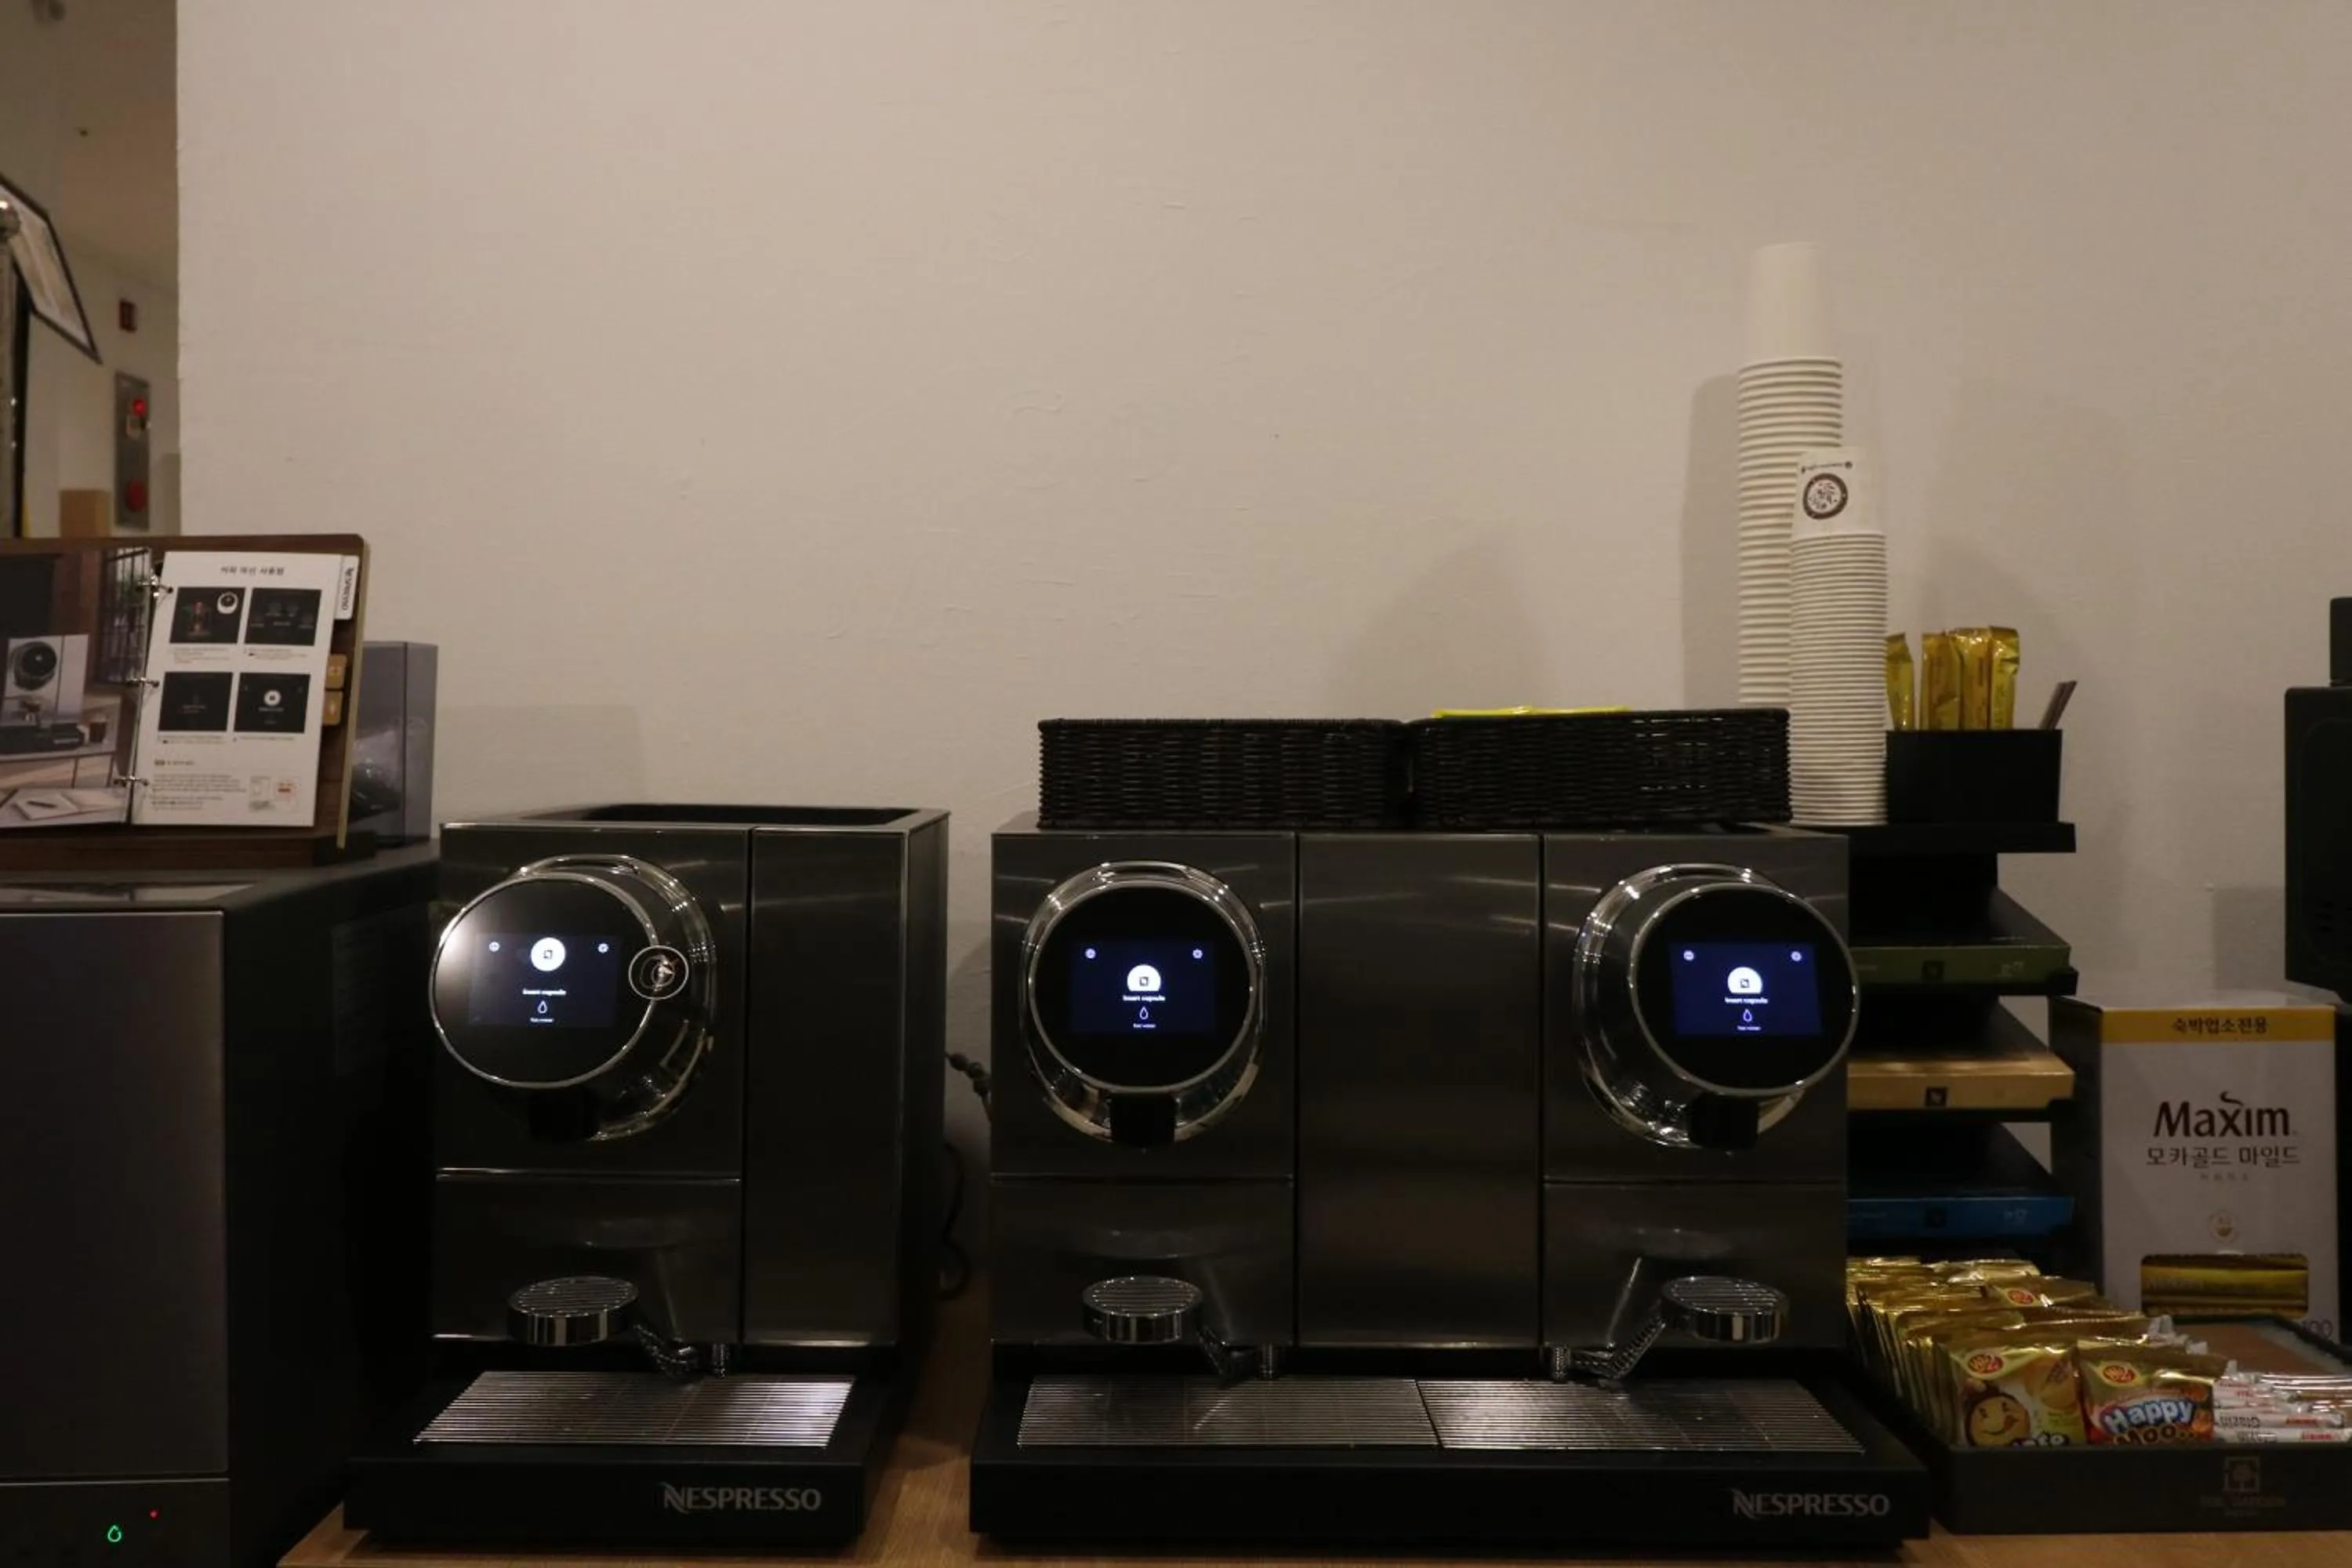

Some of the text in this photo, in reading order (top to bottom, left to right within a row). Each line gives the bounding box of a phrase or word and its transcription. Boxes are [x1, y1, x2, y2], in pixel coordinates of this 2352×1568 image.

[2171, 1016, 2270, 1036] 숙박업소전용
[2153, 1091, 2290, 1138] Maxim
[2146, 1145, 2300, 1169] 모카골드 마일드
[2102, 1399, 2194, 1434] Happy
[656, 1481, 822, 1515] NESPRESSO
[1726, 1487, 1892, 1520] NESPRESSO
